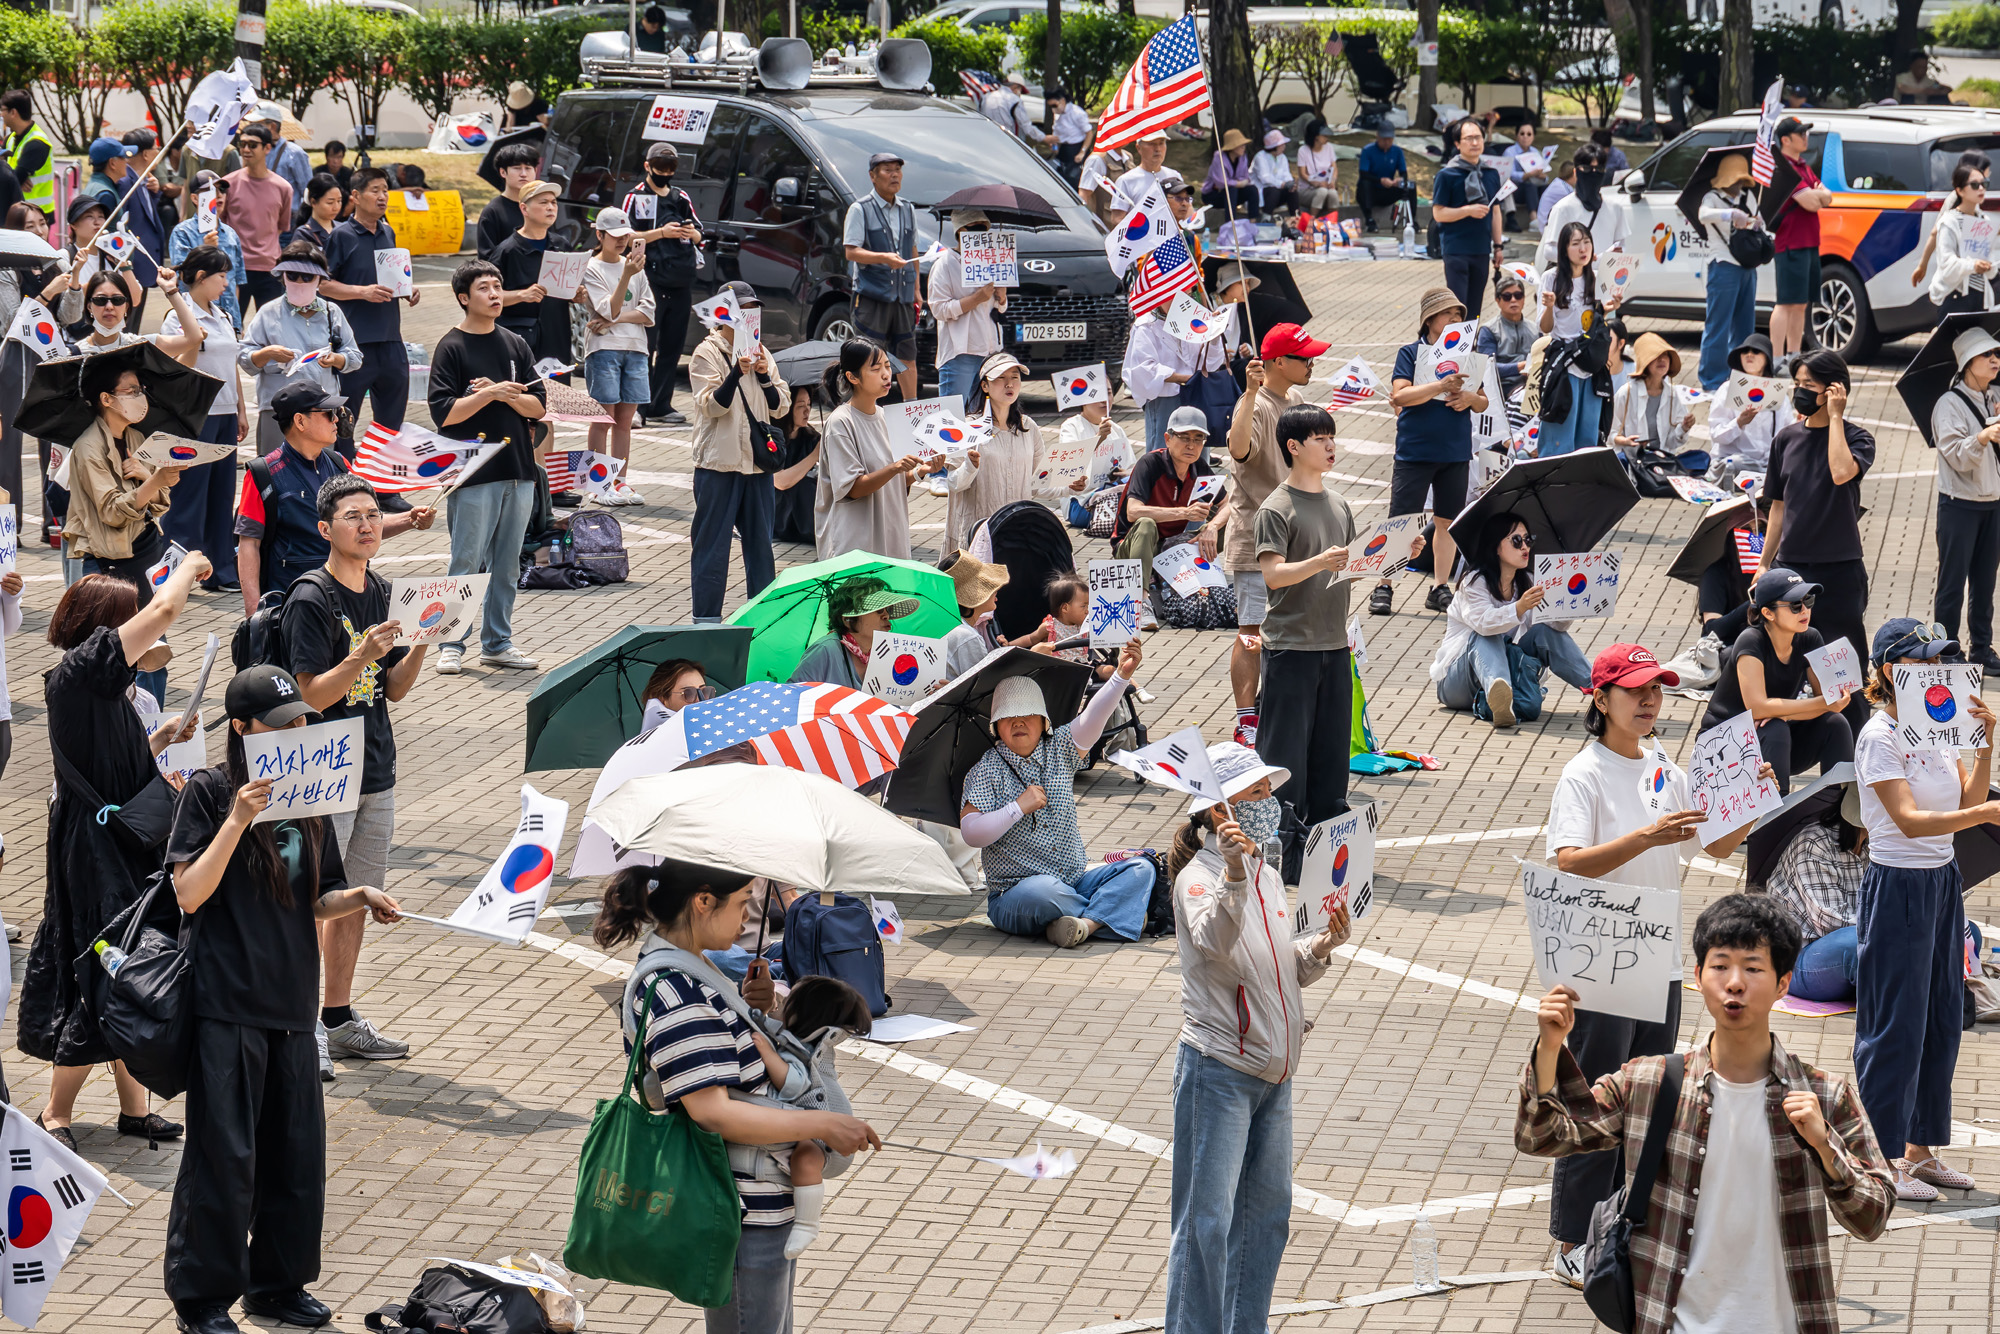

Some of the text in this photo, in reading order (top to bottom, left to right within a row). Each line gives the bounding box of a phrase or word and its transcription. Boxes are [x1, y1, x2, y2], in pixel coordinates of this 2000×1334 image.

[962, 233, 993, 249] 당일투표
[964, 247, 1015, 264] 전자투표 금지
[965, 262, 1018, 281] 외국인투표금지
[1025, 325, 1084, 339] 702우 5512
[905, 403, 941, 418] 부정선거
[1048, 447, 1085, 463] 부정선거
[1057, 466, 1085, 478] 재선거
[1346, 552, 1388, 573] 재선거
[1556, 553, 1603, 573] 부정선거
[418, 578, 458, 600] 부정선거
[1555, 594, 1591, 610] 재선거
[893, 637, 925, 653] 부정선거
[1822, 647, 1849, 668] STOP
[1835, 669, 1848, 679] THE
[1918, 669, 1954, 688] 당일투표
[271, 675, 294, 696] LA
[886, 687, 916, 699] 재선거
[1828, 679, 1859, 698] STEAL
[1926, 726, 1964, 746] 수개표
[1717, 781, 1772, 823] 부정선거
[1328, 815, 1358, 852] 부정선거
[1523, 871, 1641, 917] Election Fraud
[1581, 915, 1673, 942] ALLIANCE
[594, 1167, 674, 1216] Merci
[593, 1197, 613, 1213] Paris
